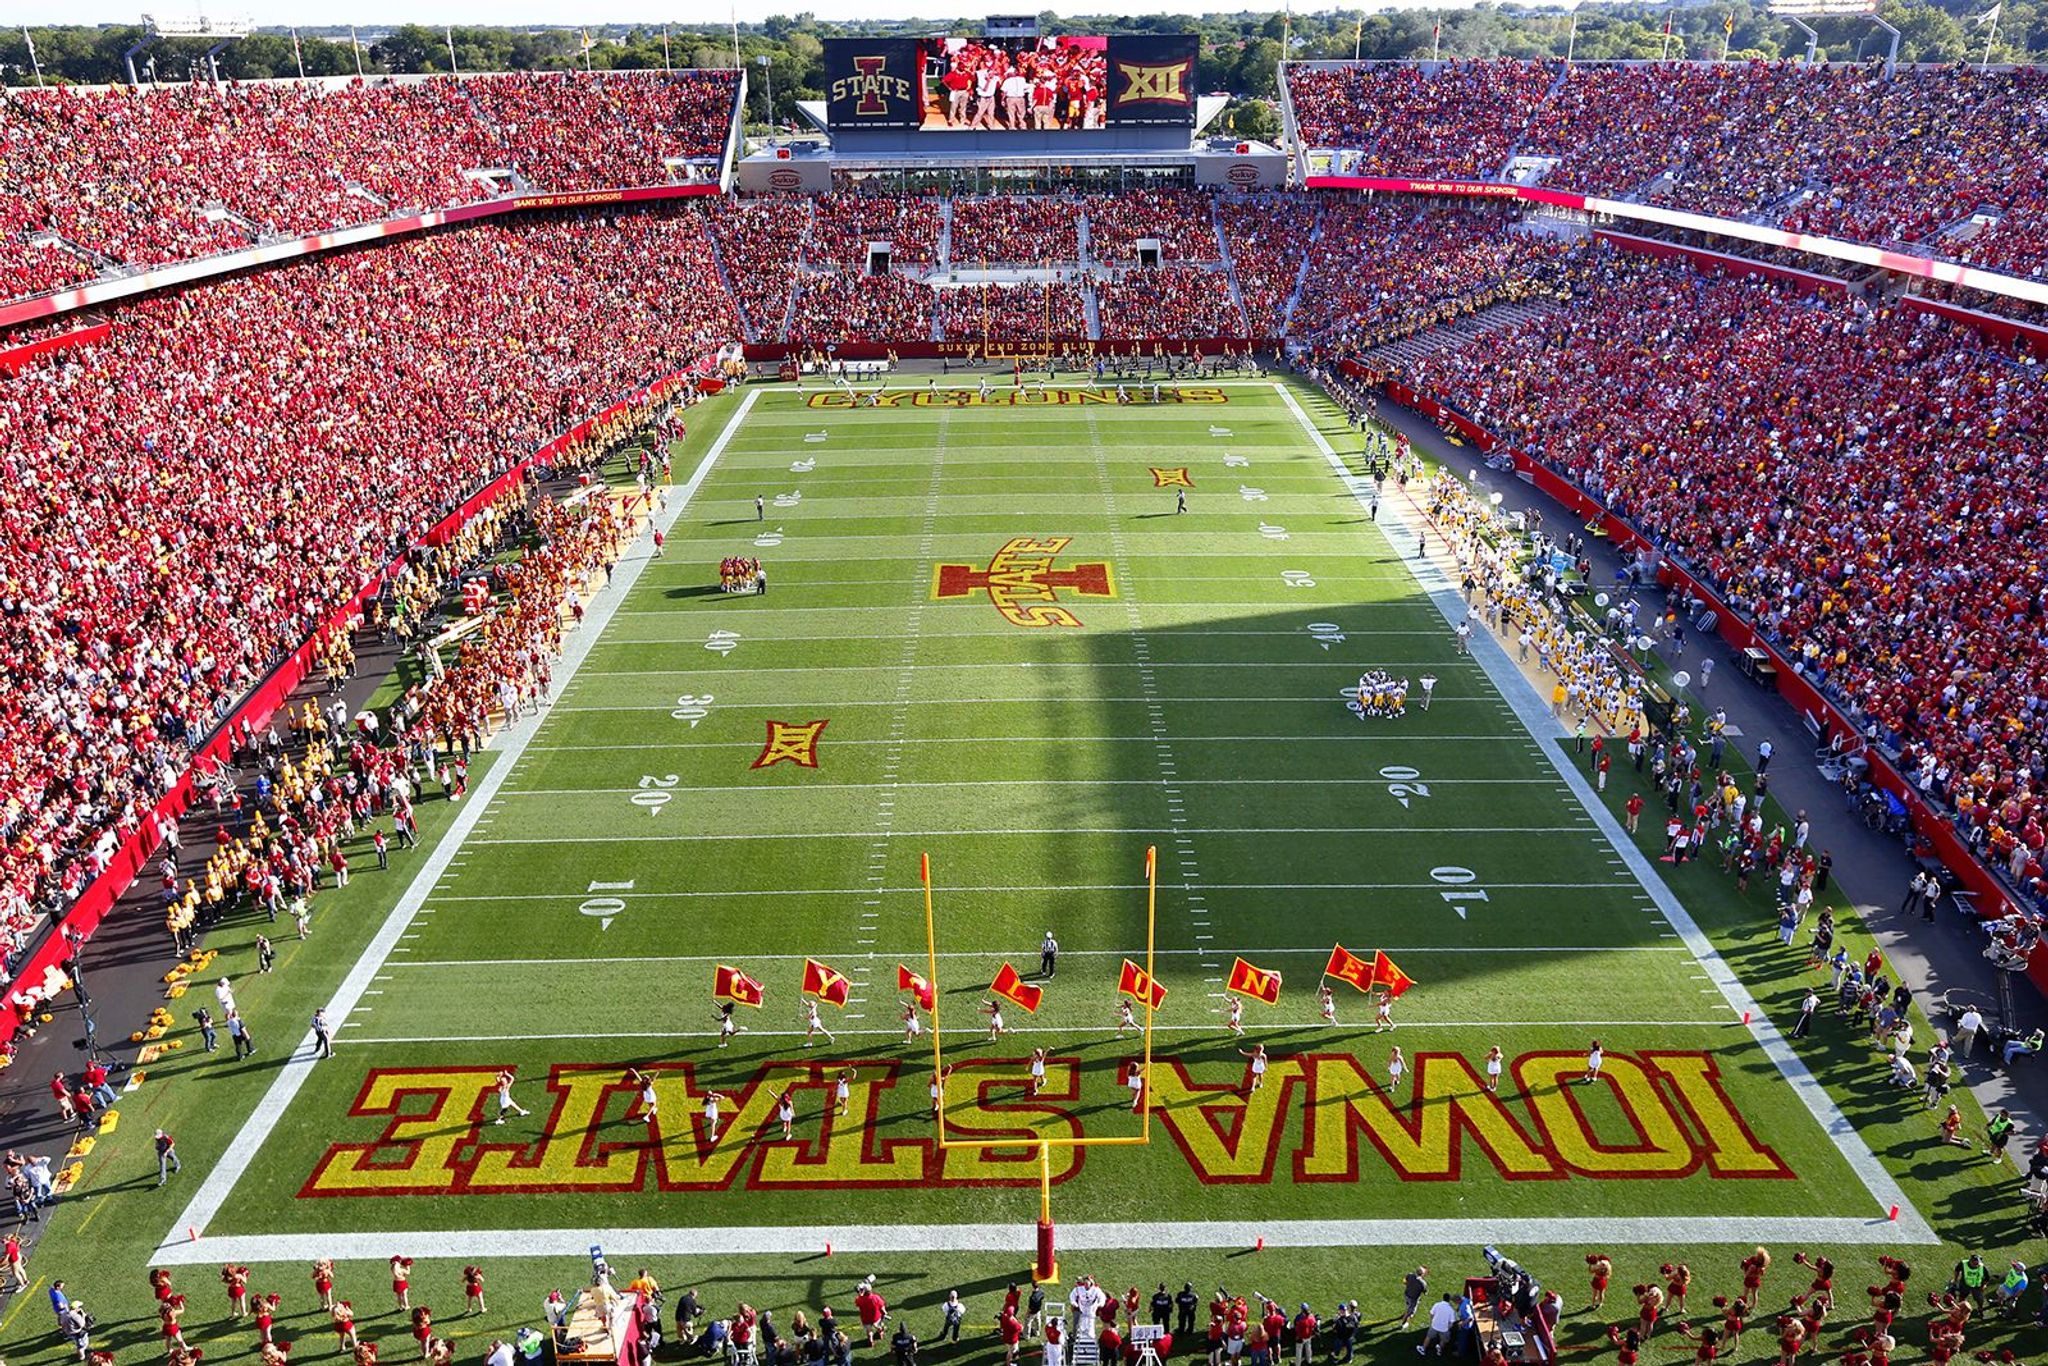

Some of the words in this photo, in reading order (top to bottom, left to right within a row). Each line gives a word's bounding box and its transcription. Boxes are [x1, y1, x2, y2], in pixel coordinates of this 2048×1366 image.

[832, 75, 910, 102] STATE
[1117, 61, 1190, 104] XII
[538, 197, 553, 206] YOU
[557, 196, 567, 204] TO
[568, 195, 583, 204] OUR
[585, 192, 623, 202] SPONSORS
[1410, 183, 1436, 191] THANK
[1455, 184, 1466, 192] TO
[1467, 185, 1483, 193] OUR
[1484, 186, 1518, 196] SPONSORS
[988, 343, 1014, 351] END
[1021, 343, 1055, 351] ZONE
[807, 388, 1229, 408] CYCLONES
[987, 537, 1084, 628] STATE
[704, 629, 741, 650] 40
[1307, 622, 1347, 644] 40
[671, 694, 714, 720] 30
[630, 774, 680, 806] 20
[1379, 766, 1431, 797] 20
[1430, 866, 1489, 902] 10
[579, 880, 635, 917] 10
[1339, 955, 1364, 980] E
[1245, 968, 1270, 996] N
[294, 1058, 1086, 1199] STATE
[1117, 1050, 1799, 1185] IOWA
